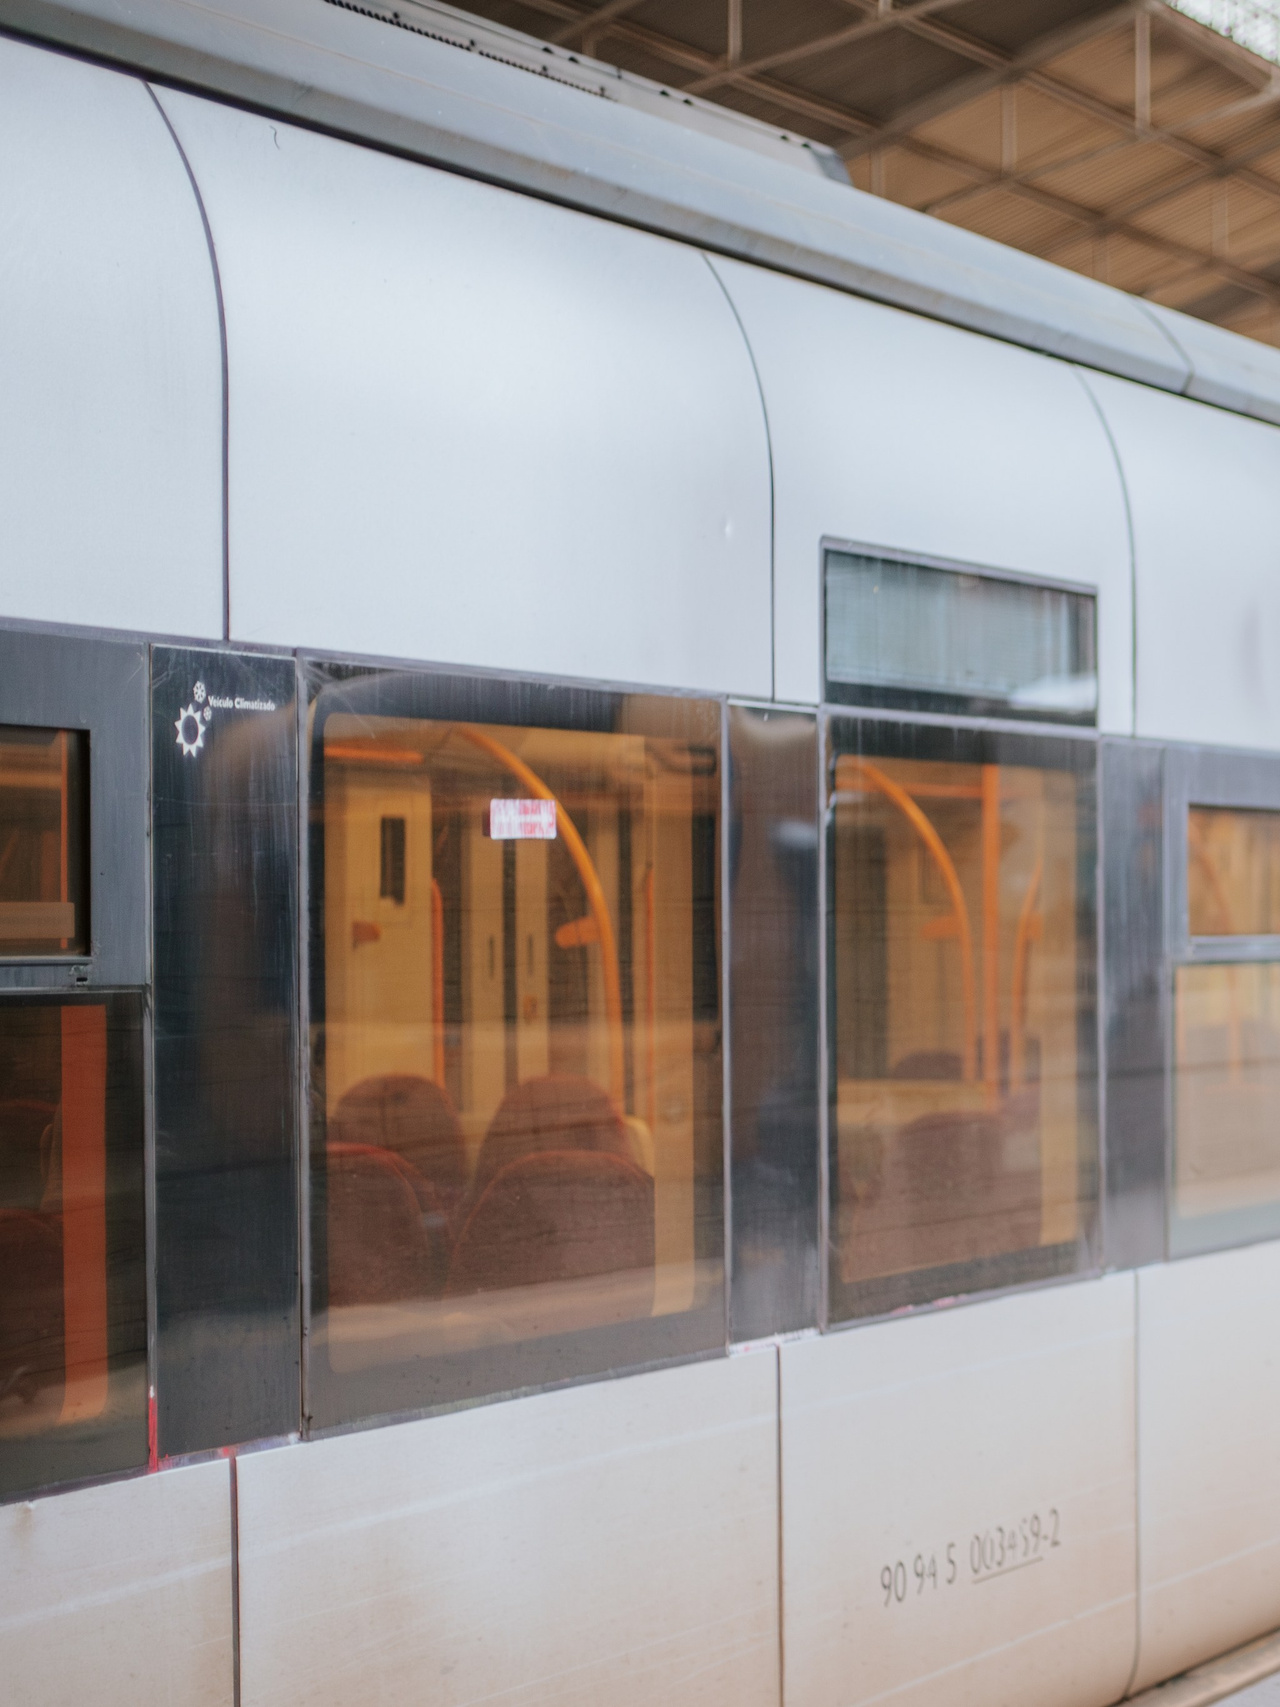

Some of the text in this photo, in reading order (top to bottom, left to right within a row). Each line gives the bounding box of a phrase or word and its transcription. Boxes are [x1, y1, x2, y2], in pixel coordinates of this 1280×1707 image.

[234, 697, 276, 711] Climatizado
[881, 1560, 907, 1607] 90
[946, 1542, 956, 1585] 5
